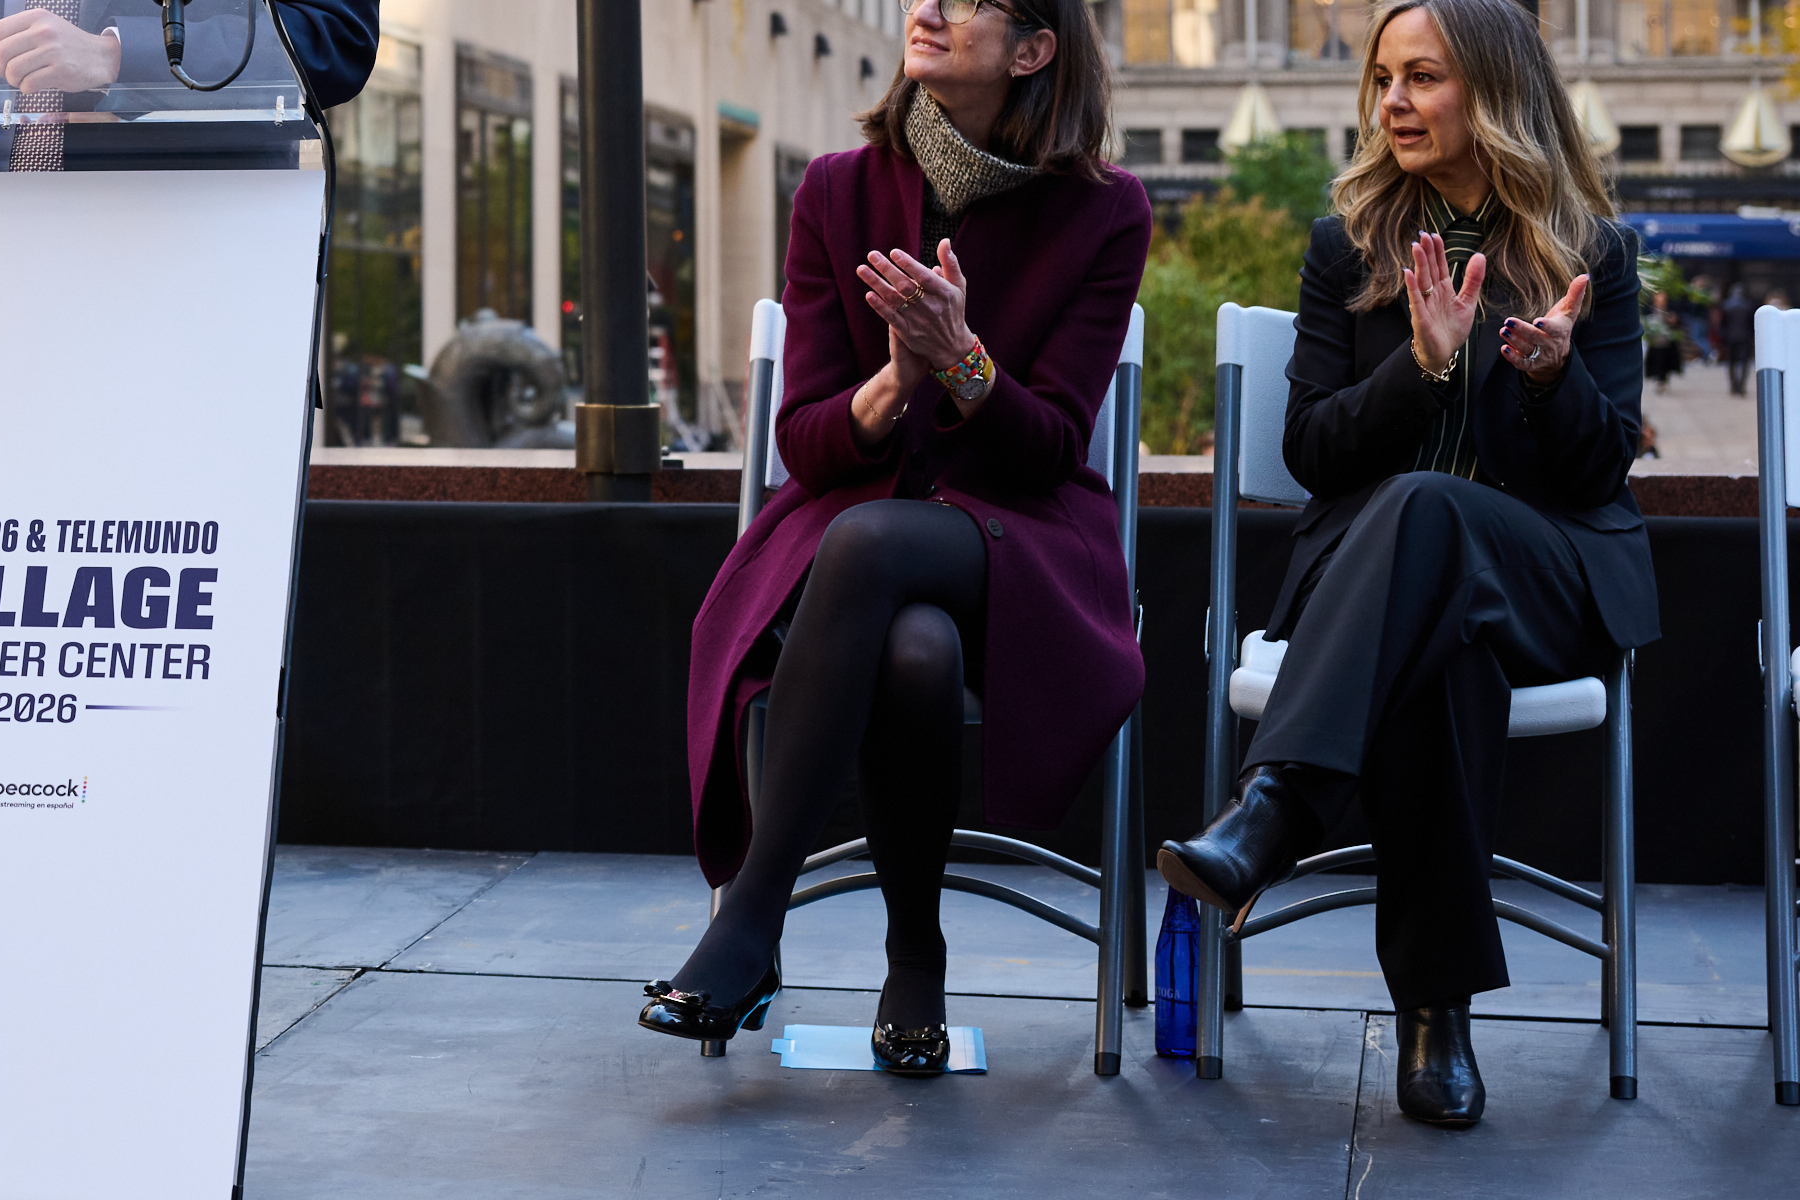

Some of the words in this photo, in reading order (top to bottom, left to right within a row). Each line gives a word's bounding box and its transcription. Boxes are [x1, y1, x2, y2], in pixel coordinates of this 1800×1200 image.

[26, 518, 46, 553] &
[56, 519, 218, 555] TELEMUNDO
[58, 641, 211, 680] CENTER
[0, 802, 35, 810] streaming
[46, 802, 75, 810] español
[1155, 985, 1181, 999] TOGA
